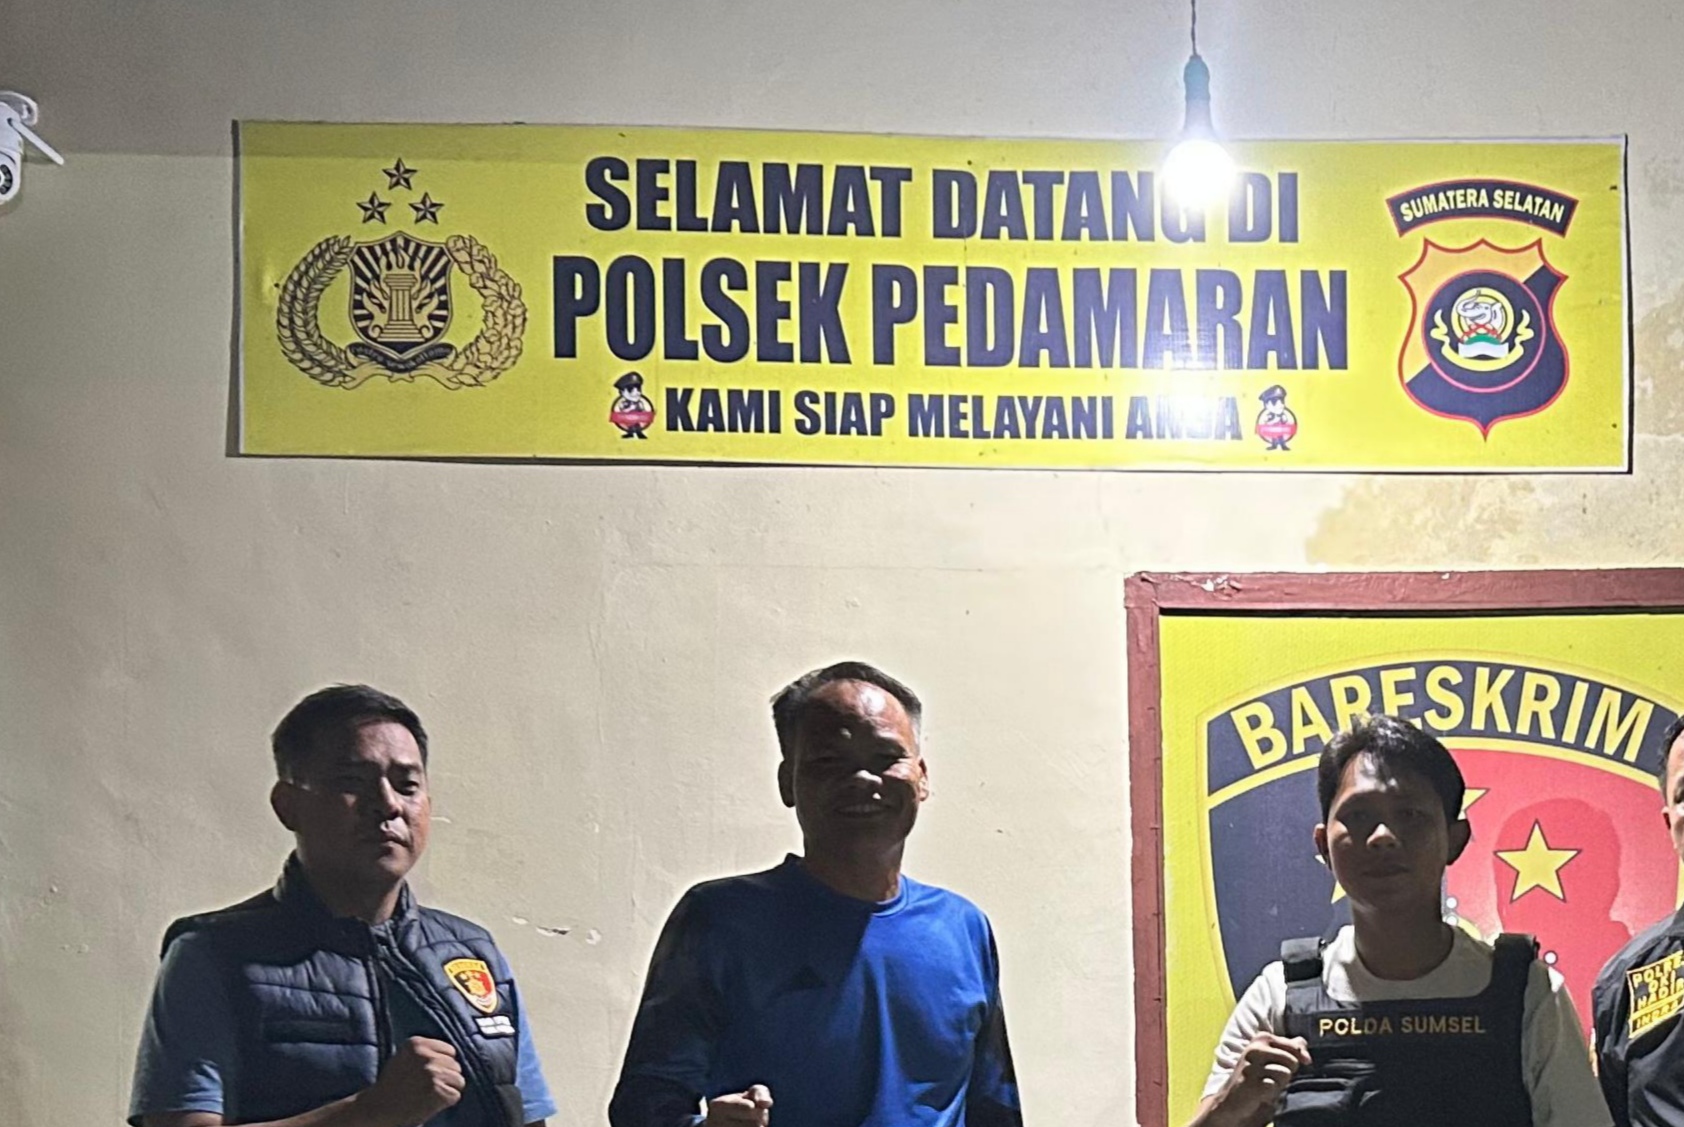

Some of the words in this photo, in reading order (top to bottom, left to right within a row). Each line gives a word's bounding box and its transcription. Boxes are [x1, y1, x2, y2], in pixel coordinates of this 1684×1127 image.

[584, 156, 912, 238] SELAMAT
[1228, 171, 1299, 244] DI
[1400, 187, 1490, 223] SUMATERA
[1492, 188, 1565, 224] SELATAN
[552, 255, 852, 366] POLSEK
[873, 263, 1349, 371] PEDAMARAN
[665, 387, 782, 435] KAMI
[794, 389, 895, 437] SIAP
[907, 393, 1114, 441] MELAYANI
[1318, 1015, 1394, 1037] POLDA
[1401, 1014, 1487, 1034] SUMSEL
